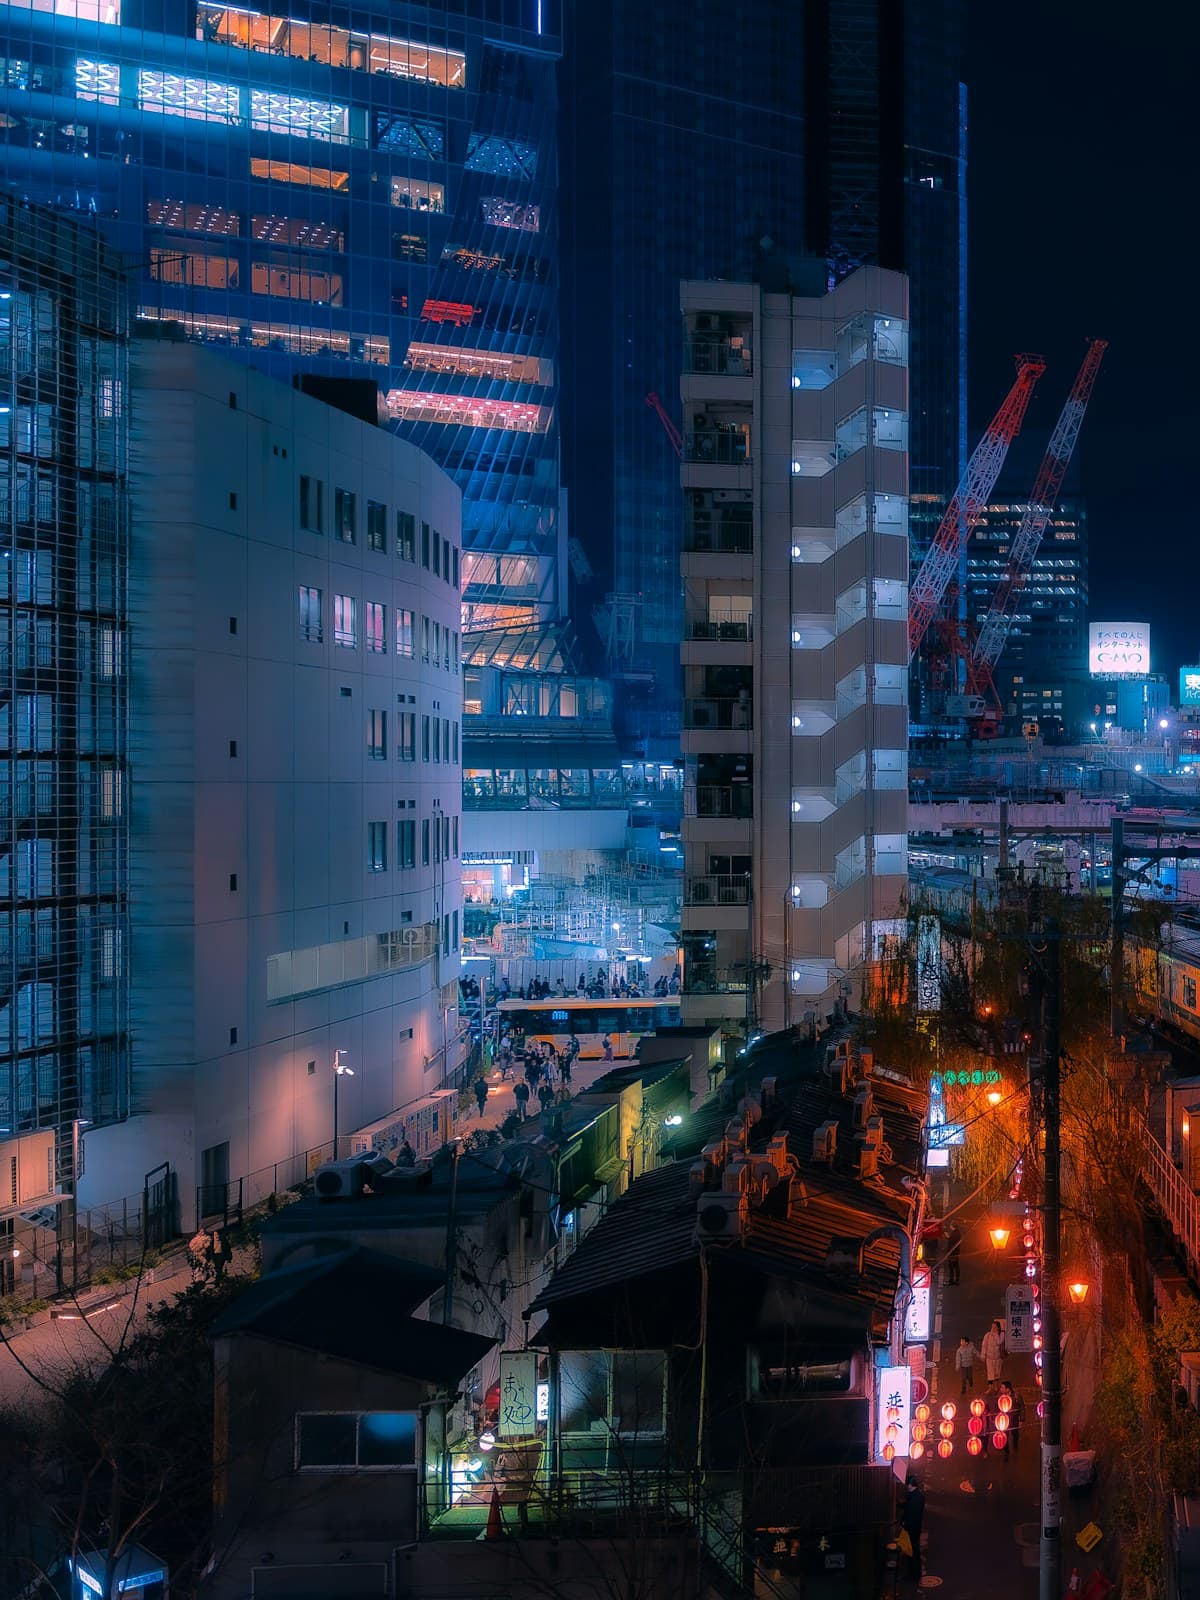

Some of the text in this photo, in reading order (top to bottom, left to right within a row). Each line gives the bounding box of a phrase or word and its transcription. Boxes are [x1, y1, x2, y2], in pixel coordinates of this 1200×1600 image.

[1097, 631, 1144, 639] すべての人に
[1097, 640, 1143, 649] インターネット
